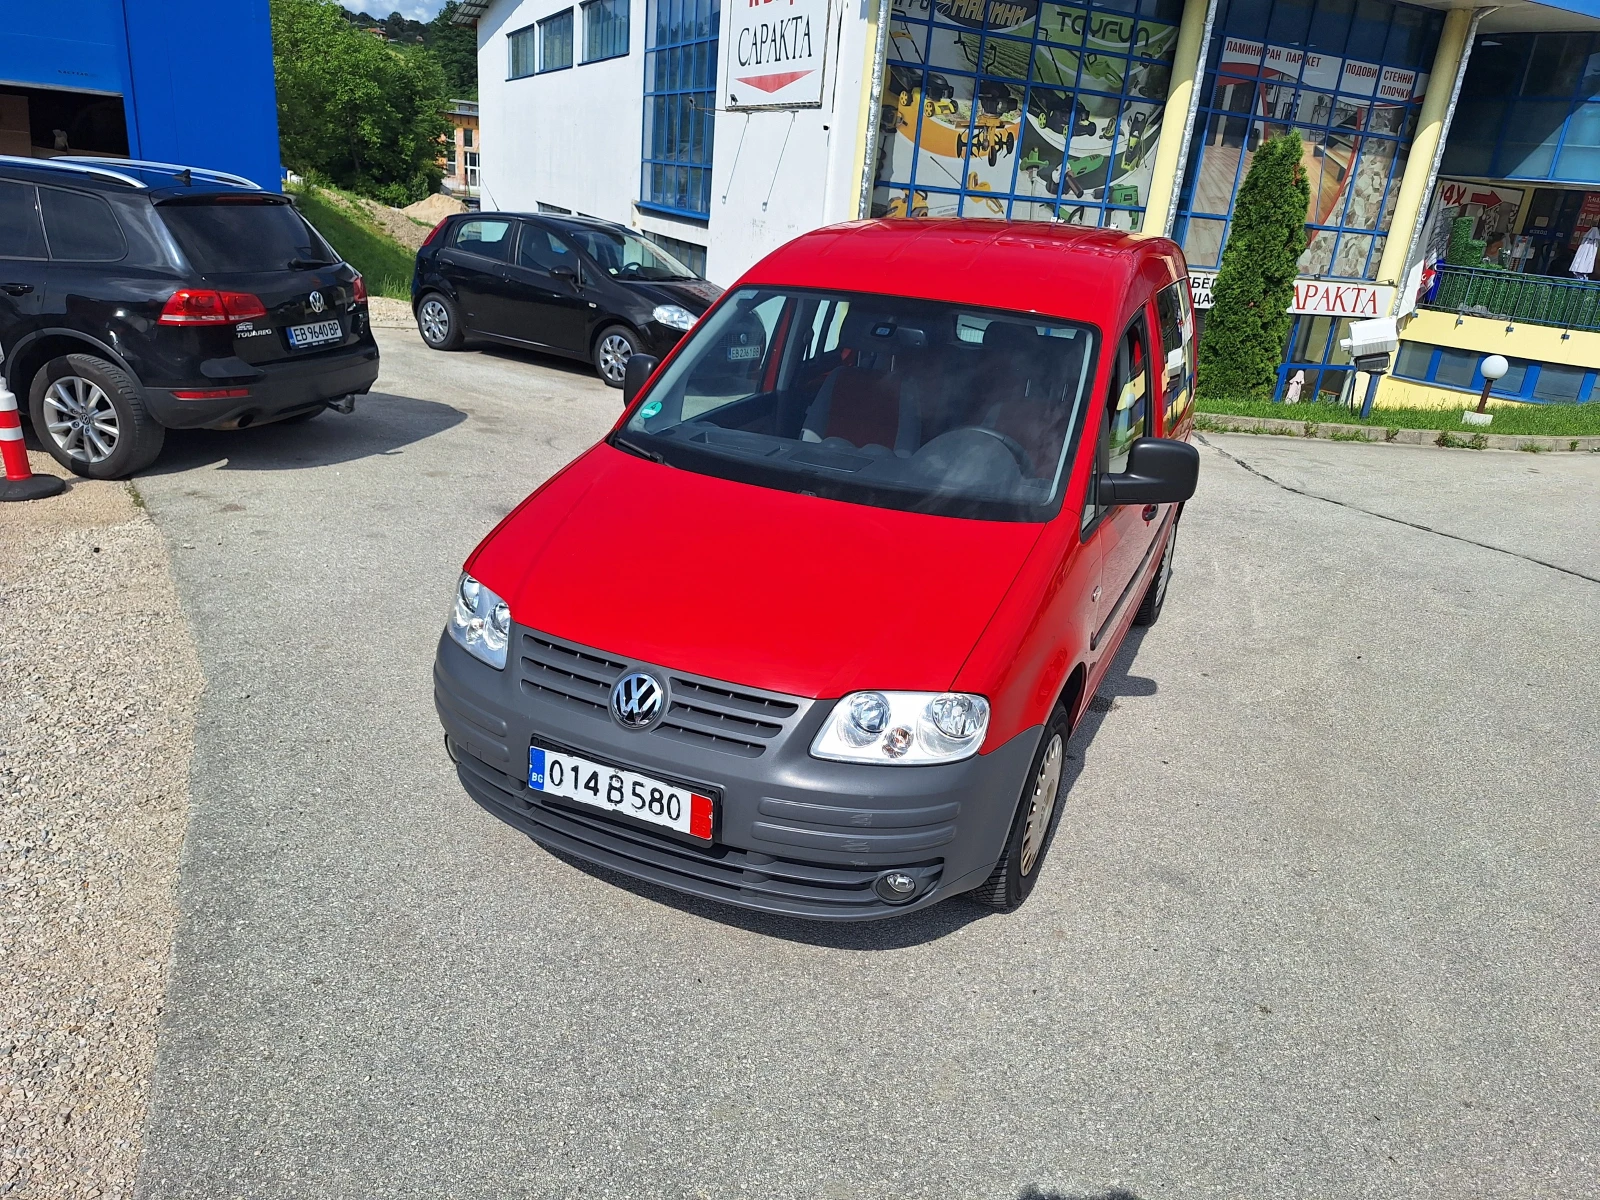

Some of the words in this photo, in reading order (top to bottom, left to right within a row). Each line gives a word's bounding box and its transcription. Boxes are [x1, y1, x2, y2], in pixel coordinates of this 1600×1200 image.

[738, 14, 812, 67] САРАКТА
[1345, 63, 1378, 79] ПОДОВИ
[1383, 70, 1414, 85] СТЕННИ
[1380, 85, 1412, 99] ПЛОЧКИ
